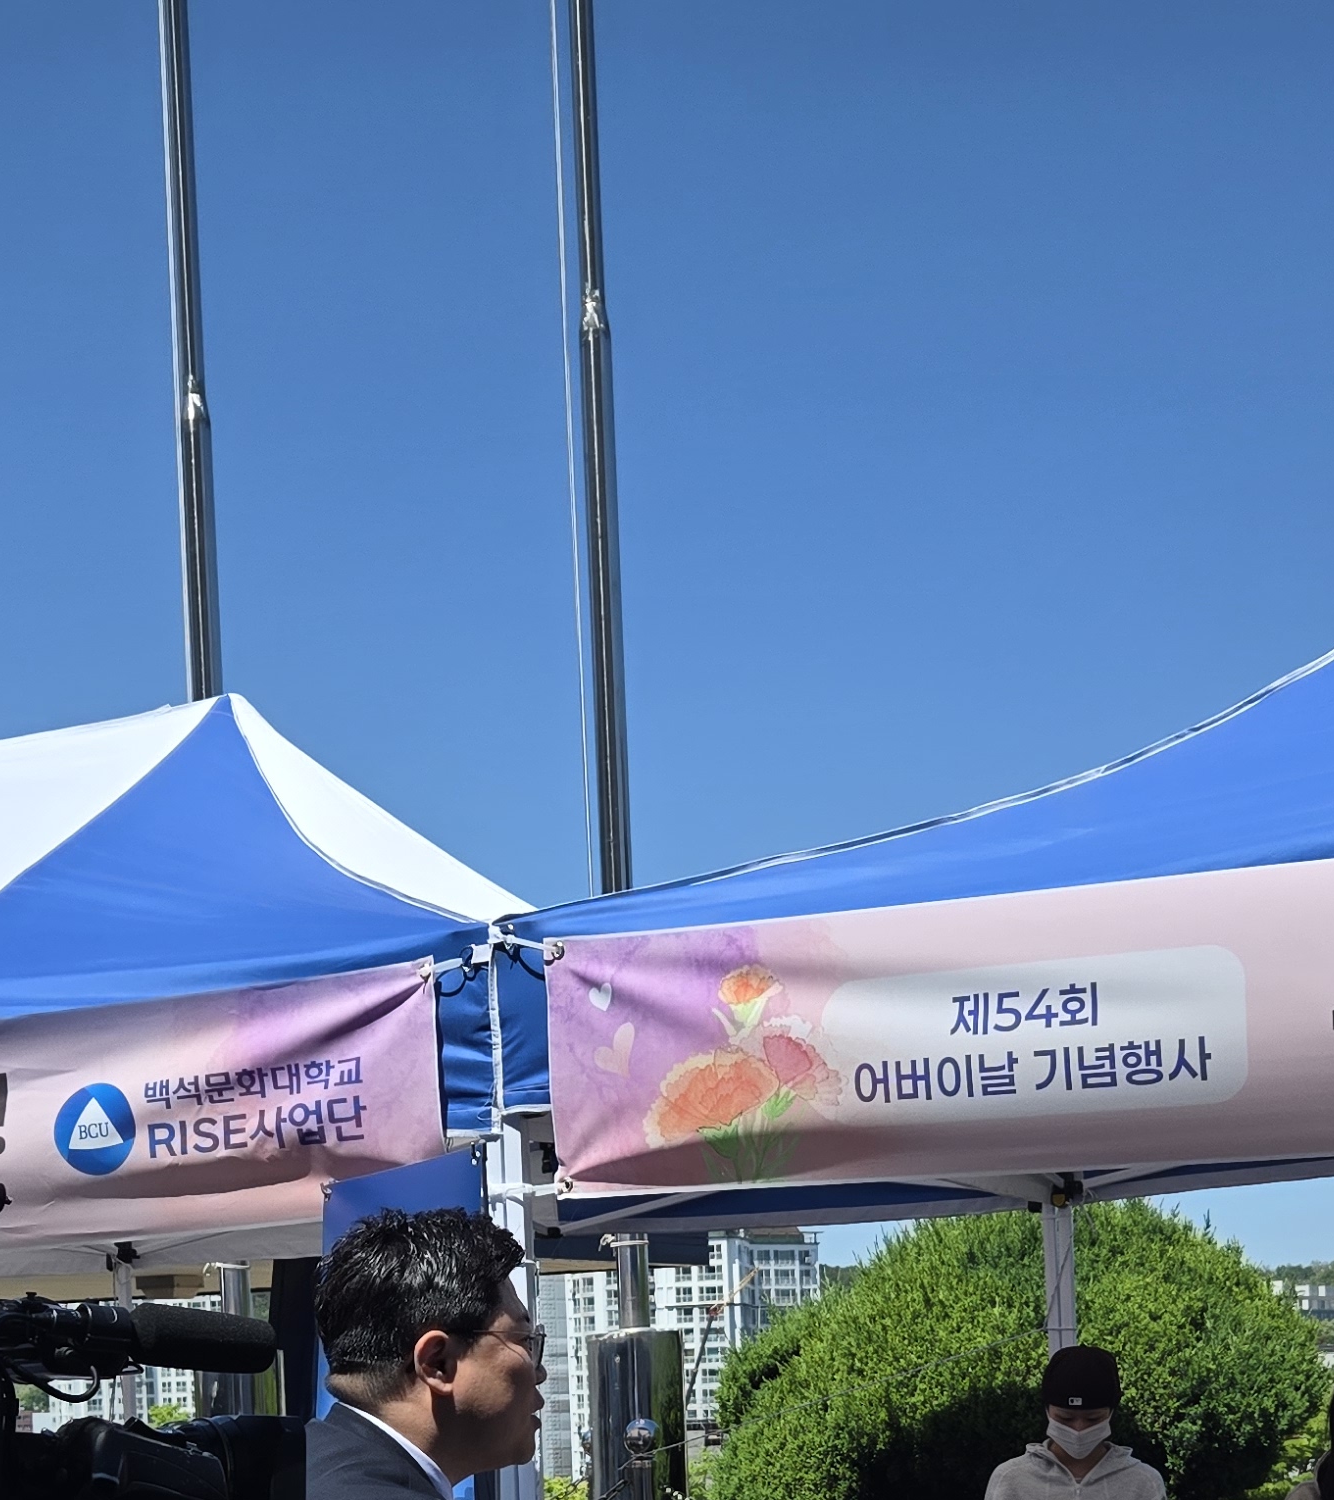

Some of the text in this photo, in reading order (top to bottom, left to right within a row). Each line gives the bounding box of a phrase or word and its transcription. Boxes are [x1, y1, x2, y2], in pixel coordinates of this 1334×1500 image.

[950, 981, 1100, 1037] 제54회
[143, 1056, 364, 1111] 백석문화대학교
[854, 1035, 1212, 1106] 어버이날 기념행사
[78, 1122, 110, 1141] BCU
[147, 1098, 367, 1159] RISE사업단
